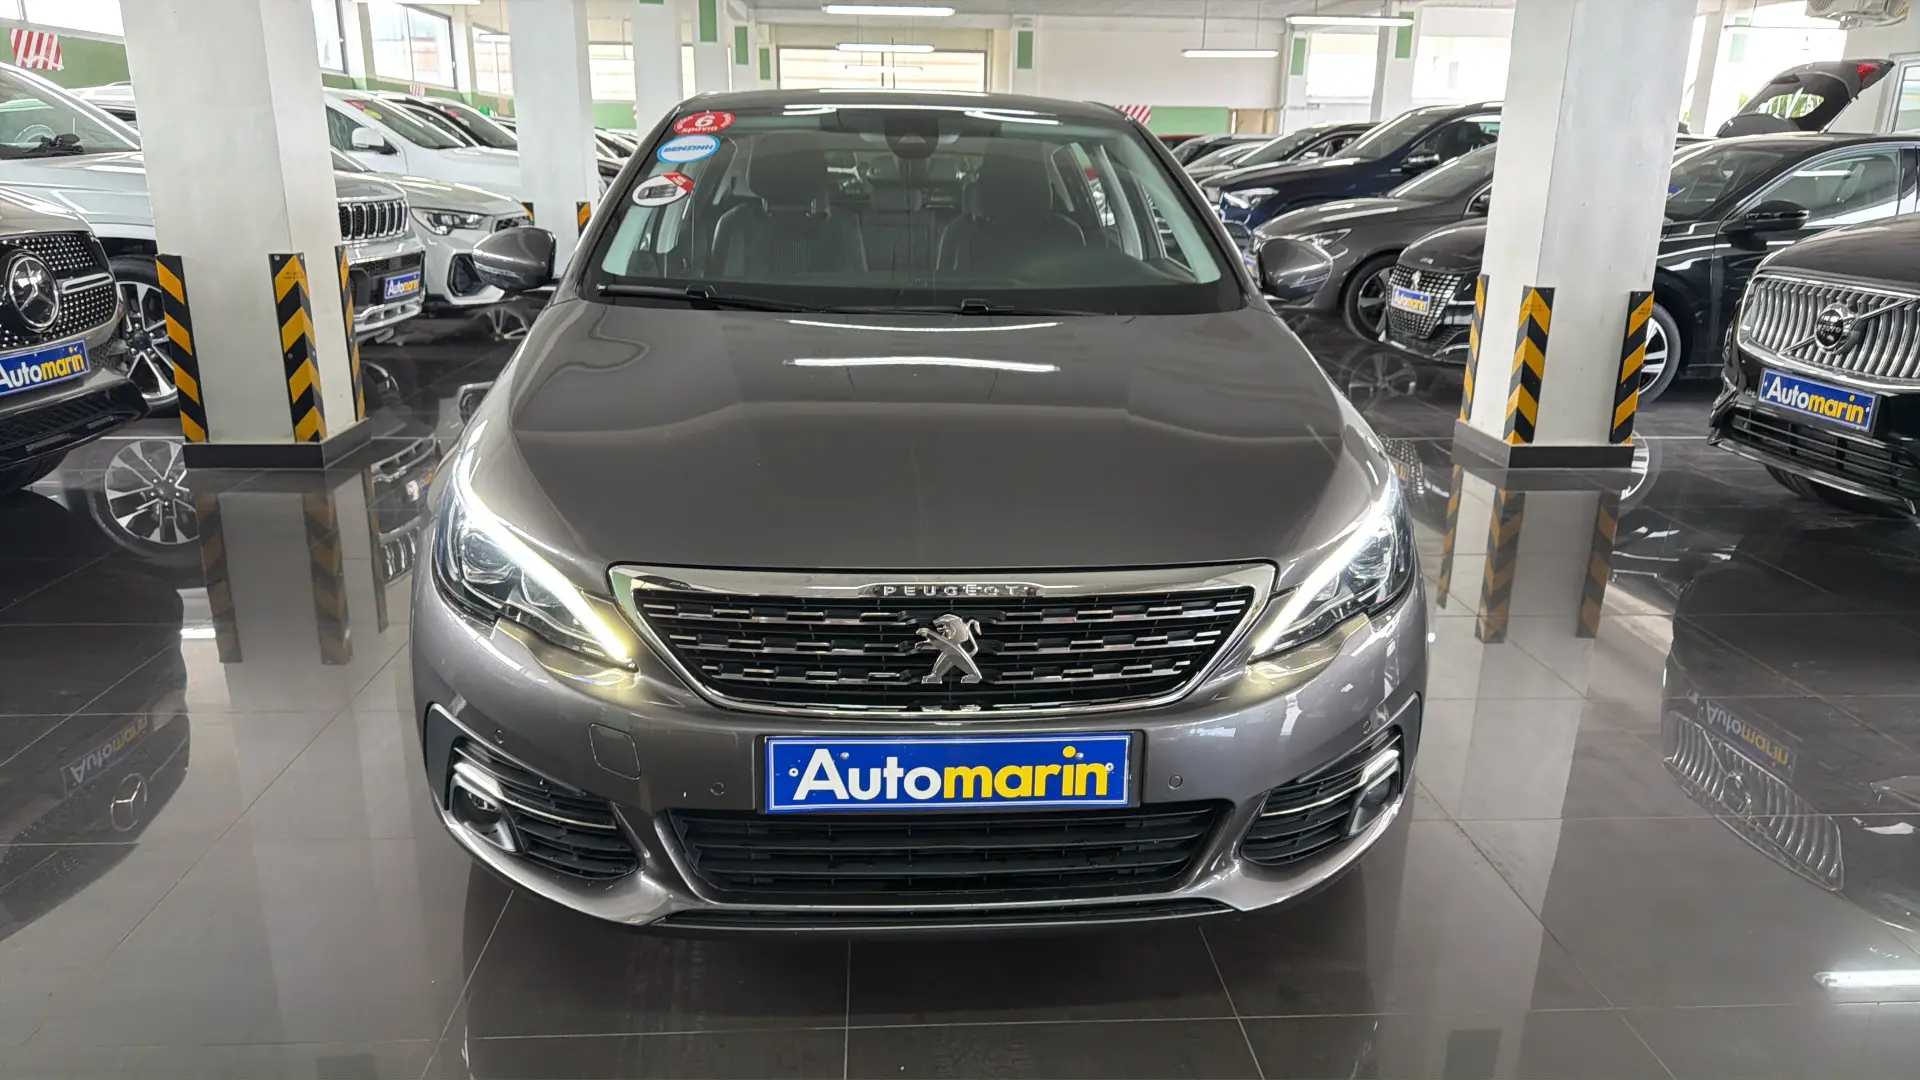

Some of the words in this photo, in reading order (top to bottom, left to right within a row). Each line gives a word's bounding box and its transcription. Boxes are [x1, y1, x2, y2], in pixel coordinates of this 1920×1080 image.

[694, 115, 716, 127] 6
[1765, 376, 1865, 424] Automarin
[883, 585, 1019, 597] PEUGEOT
[792, 745, 1108, 801] Automarin
